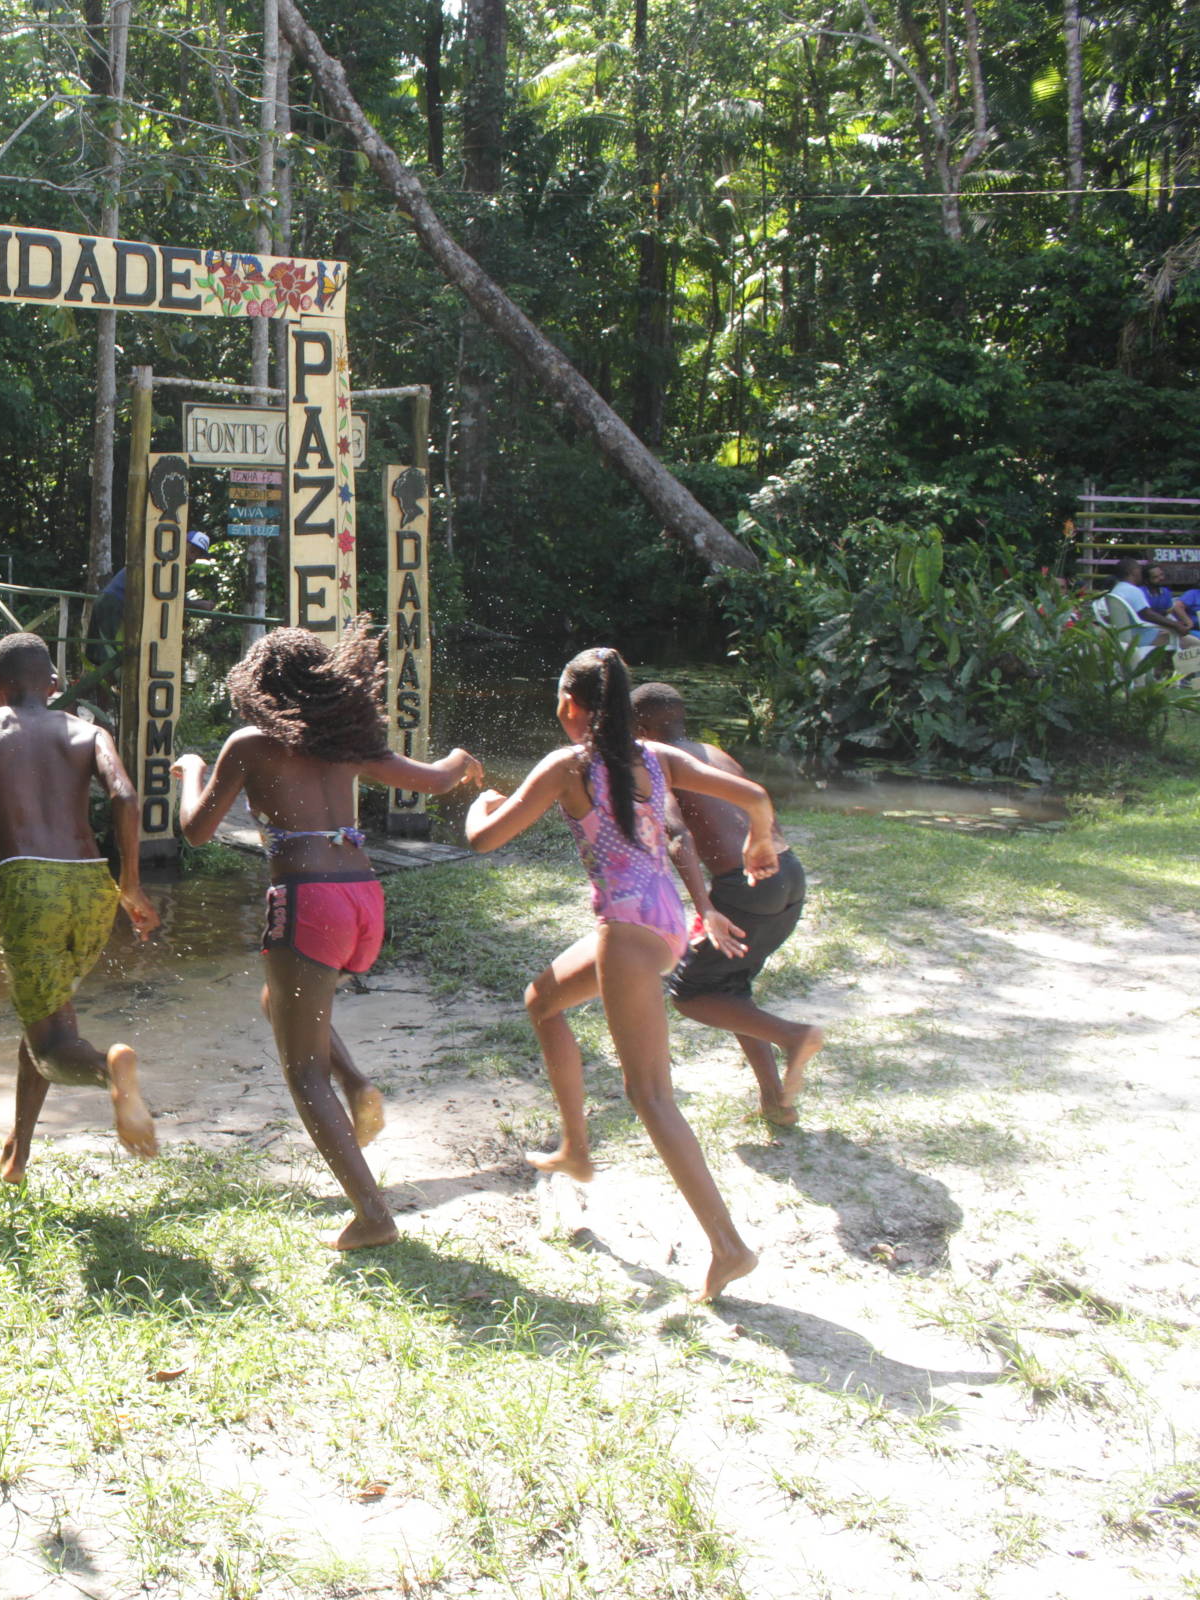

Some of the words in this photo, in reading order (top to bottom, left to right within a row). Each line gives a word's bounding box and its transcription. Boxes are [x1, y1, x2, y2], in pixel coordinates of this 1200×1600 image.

[191, 417, 268, 455] FONTE
[291, 330, 336, 539] PAZ
[237, 507, 264, 518] VIVA
[142, 523, 181, 833] QUILOMBO
